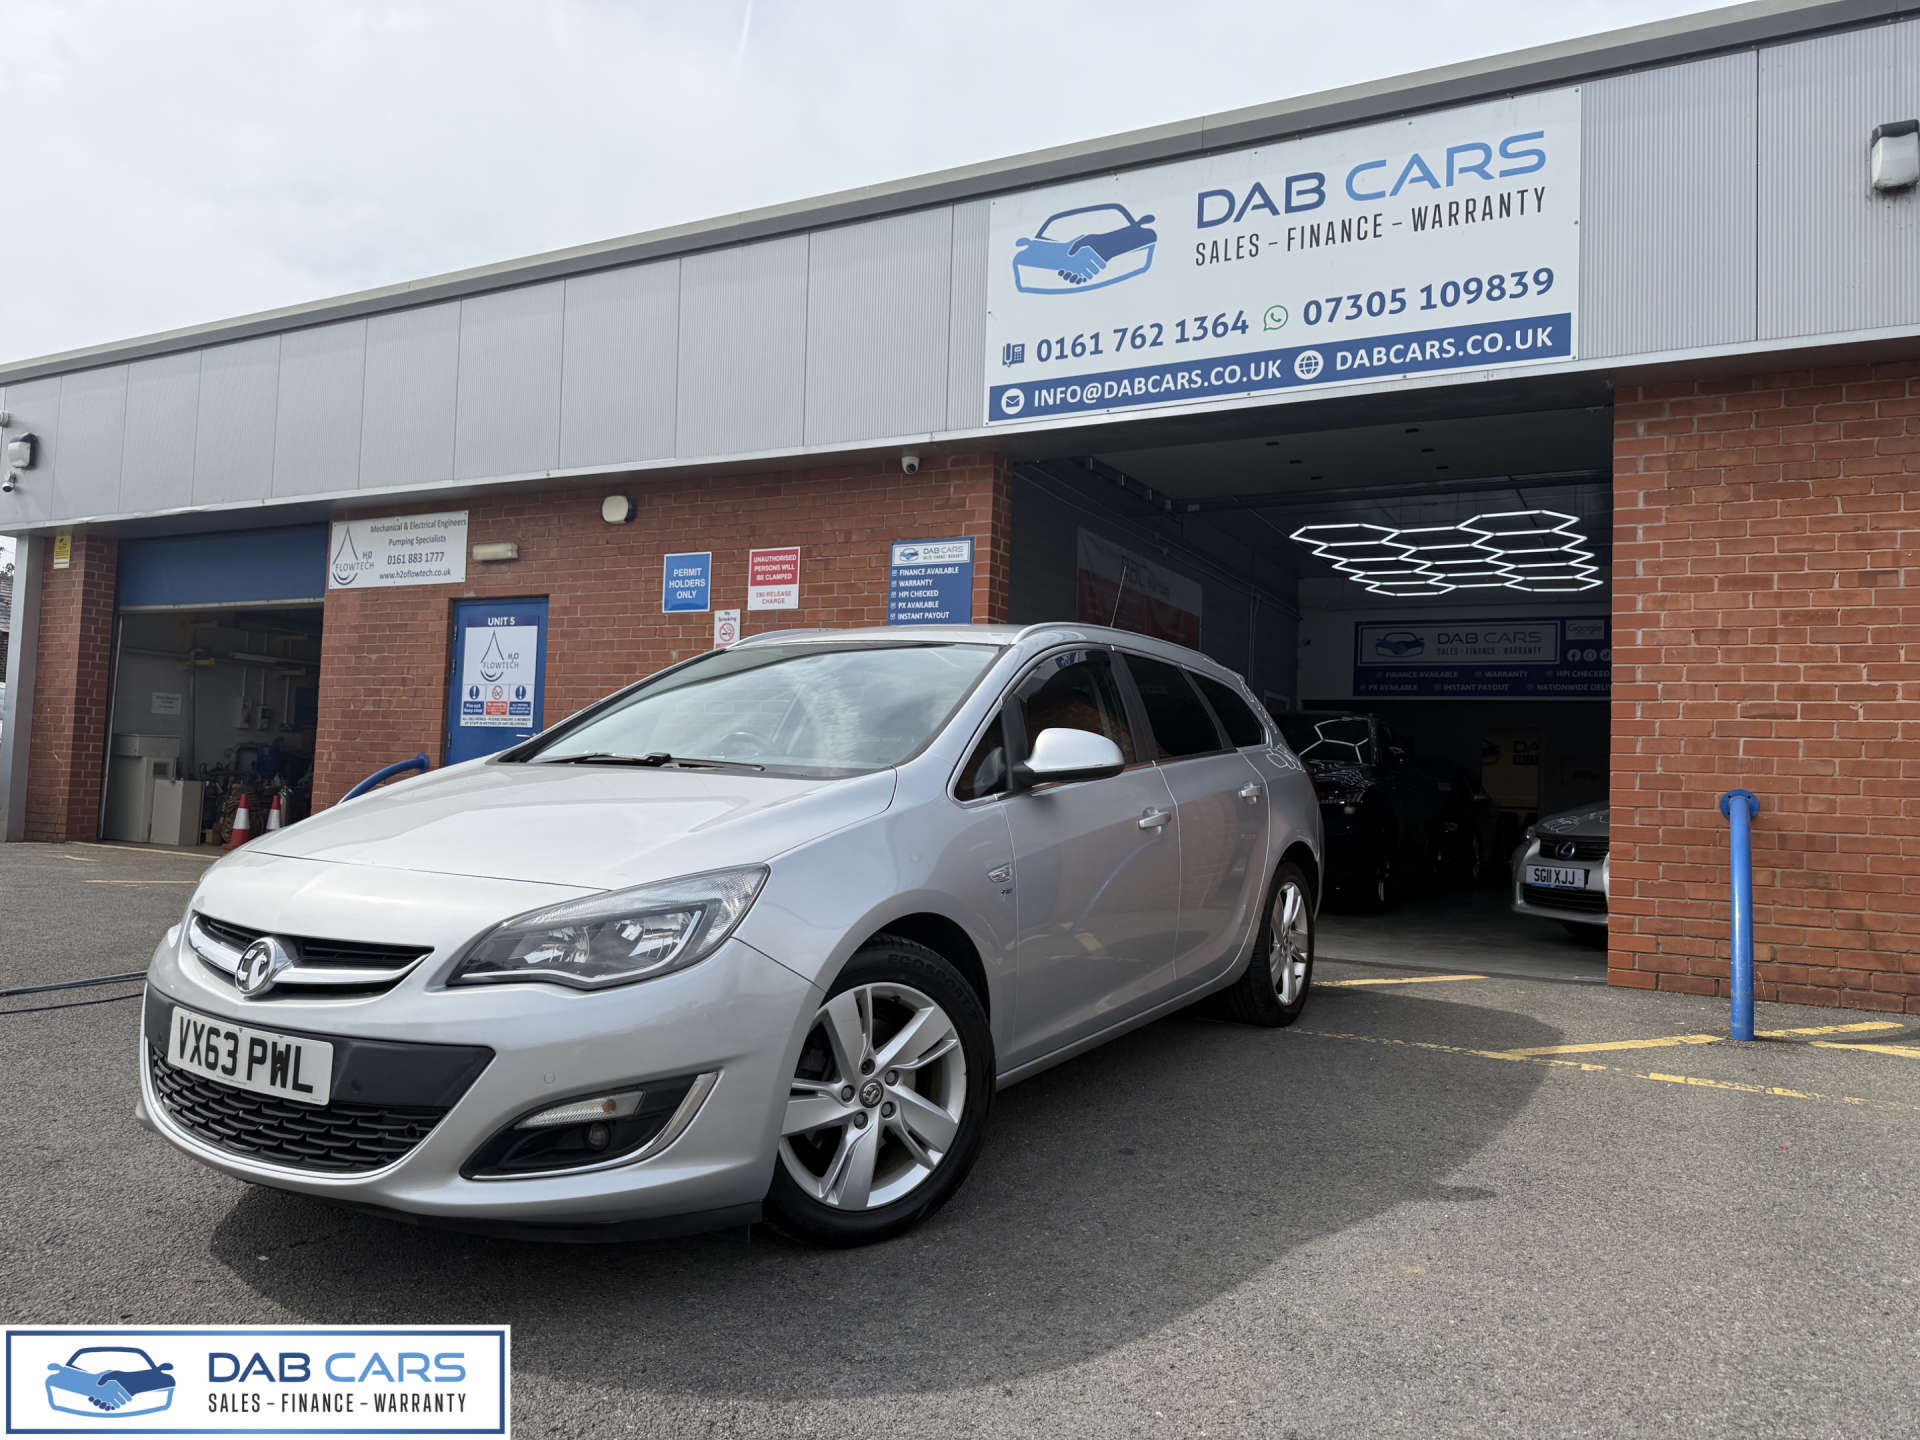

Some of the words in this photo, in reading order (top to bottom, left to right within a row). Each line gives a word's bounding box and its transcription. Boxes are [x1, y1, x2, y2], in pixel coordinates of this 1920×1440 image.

[1196, 172, 1327, 229] DAB
[1345, 130, 1547, 201] CARS
[1195, 232, 1260, 267] SALES
[1287, 213, 1384, 252] FINANCE
[1411, 186, 1546, 232] WARRANTY
[1302, 288, 1407, 325] 07305
[1419, 267, 1554, 310] 109839
[1036, 331, 1103, 363] 0161
[1113, 322, 1164, 352] 762
[1175, 310, 1249, 345] 1364
[1335, 326, 1553, 371] DABCARS.CO.UK
[1033, 359, 1282, 408] INFO@DABCARS.CO.UK
[370, 523, 402, 533] Mechanical
[410, 520, 437, 530] Electrical
[438, 519, 466, 529] Engineers
[388, 537, 414, 547] Pumping
[416, 535, 446, 545] Specialists
[923, 547, 939, 555] DAB
[941, 545, 964, 553] CARS
[387, 553, 405, 565] 0161
[408, 553, 422, 564] 883
[425, 552, 444, 563] 1777
[753, 554, 797, 563] UNAUTHORISED
[335, 562, 375, 572] FLOWTECH
[673, 568, 702, 577] PERMIT
[781, 563, 796, 571] WILL
[900, 568, 925, 576] FINANCE
[926, 567, 959, 575] AVAILABLE
[380, 568, 450, 580] www.h2oflowtech.co.uk
[669, 578, 706, 589] HOLDERS
[899, 579, 933, 587] WARRANTY
[676, 590, 697, 600] ONLY
[907, 601, 939, 609] AVAILABLE
[488, 617, 506, 626] UNIT
[508, 617, 515, 625] 5
[898, 612, 923, 620] INSTANT
[1437, 632, 1479, 645] DAB
[1483, 631, 1543, 644] CARS
[483, 661, 519, 670] FLOWTECH
[1554, 870, 1575, 885] XJJ
[180, 1016, 239, 1077] VX63
[246, 1037, 313, 1094] PWL
